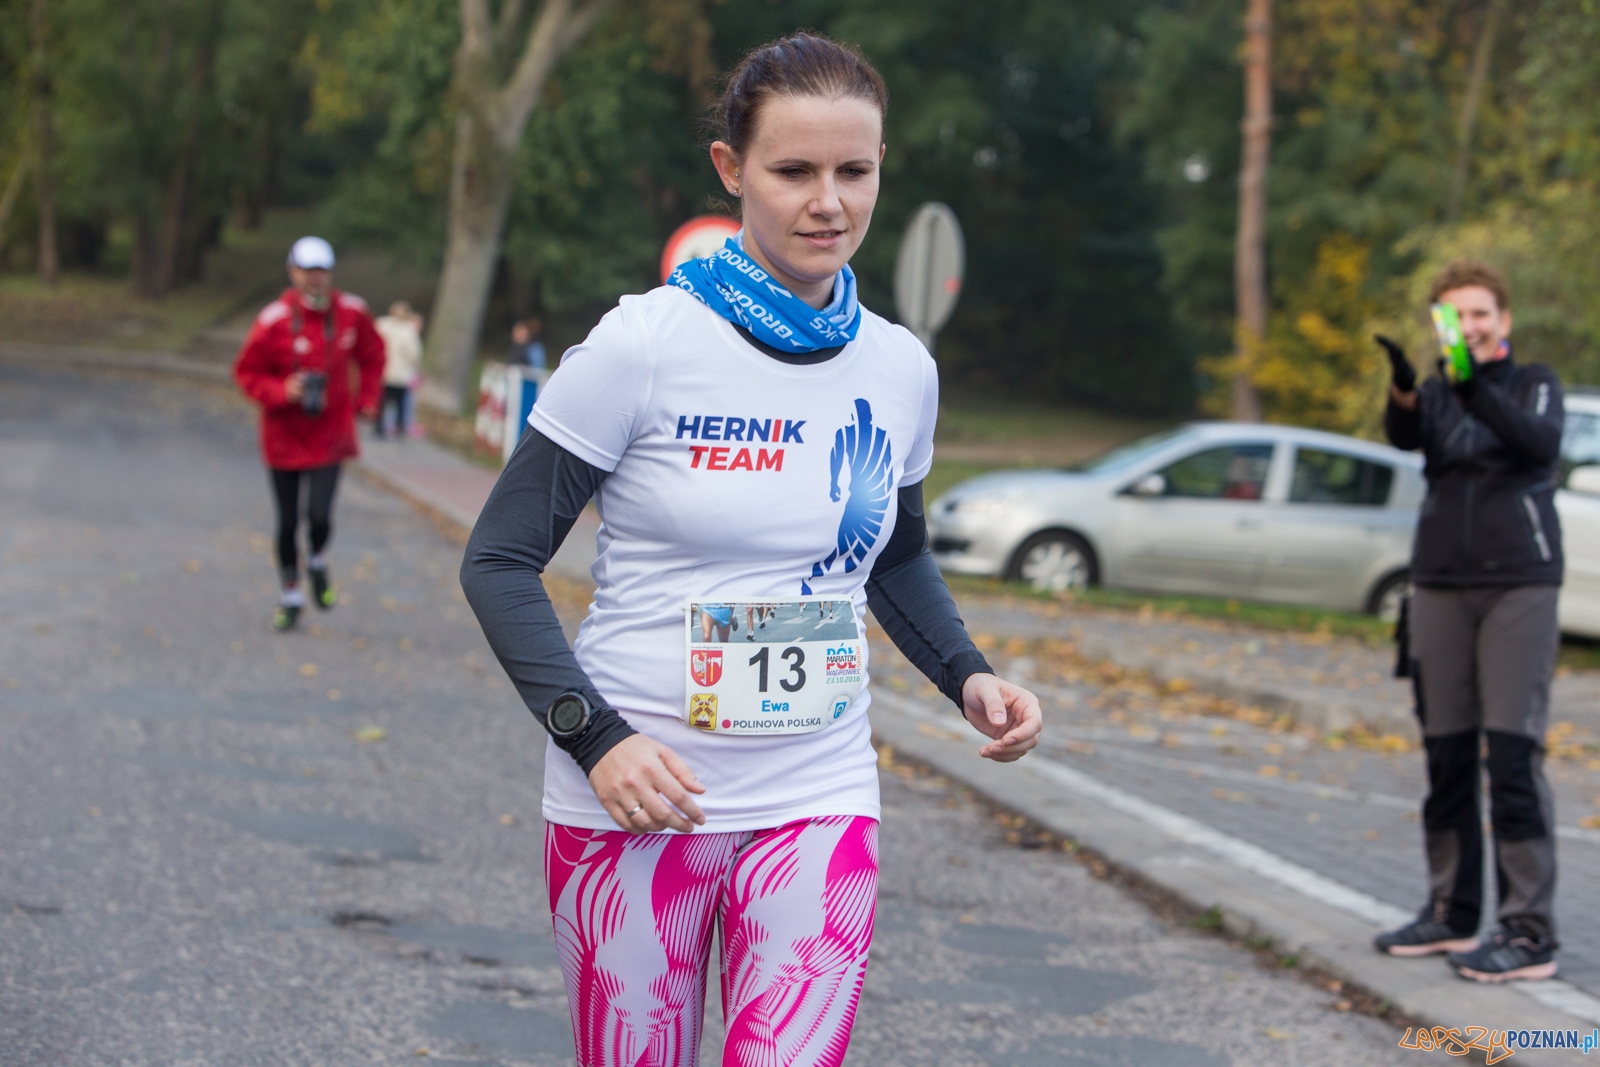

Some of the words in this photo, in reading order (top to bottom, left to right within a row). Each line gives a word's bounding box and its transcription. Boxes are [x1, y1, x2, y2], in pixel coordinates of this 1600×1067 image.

[675, 415, 807, 443] HERNIK
[688, 445, 785, 472] TEAM
[749, 646, 806, 693] 13
[826, 676, 861, 684] 23.10.2016
[761, 700, 789, 712] Ewa
[733, 720, 785, 729] POLINOVA
[787, 717, 821, 727] POLSKA
